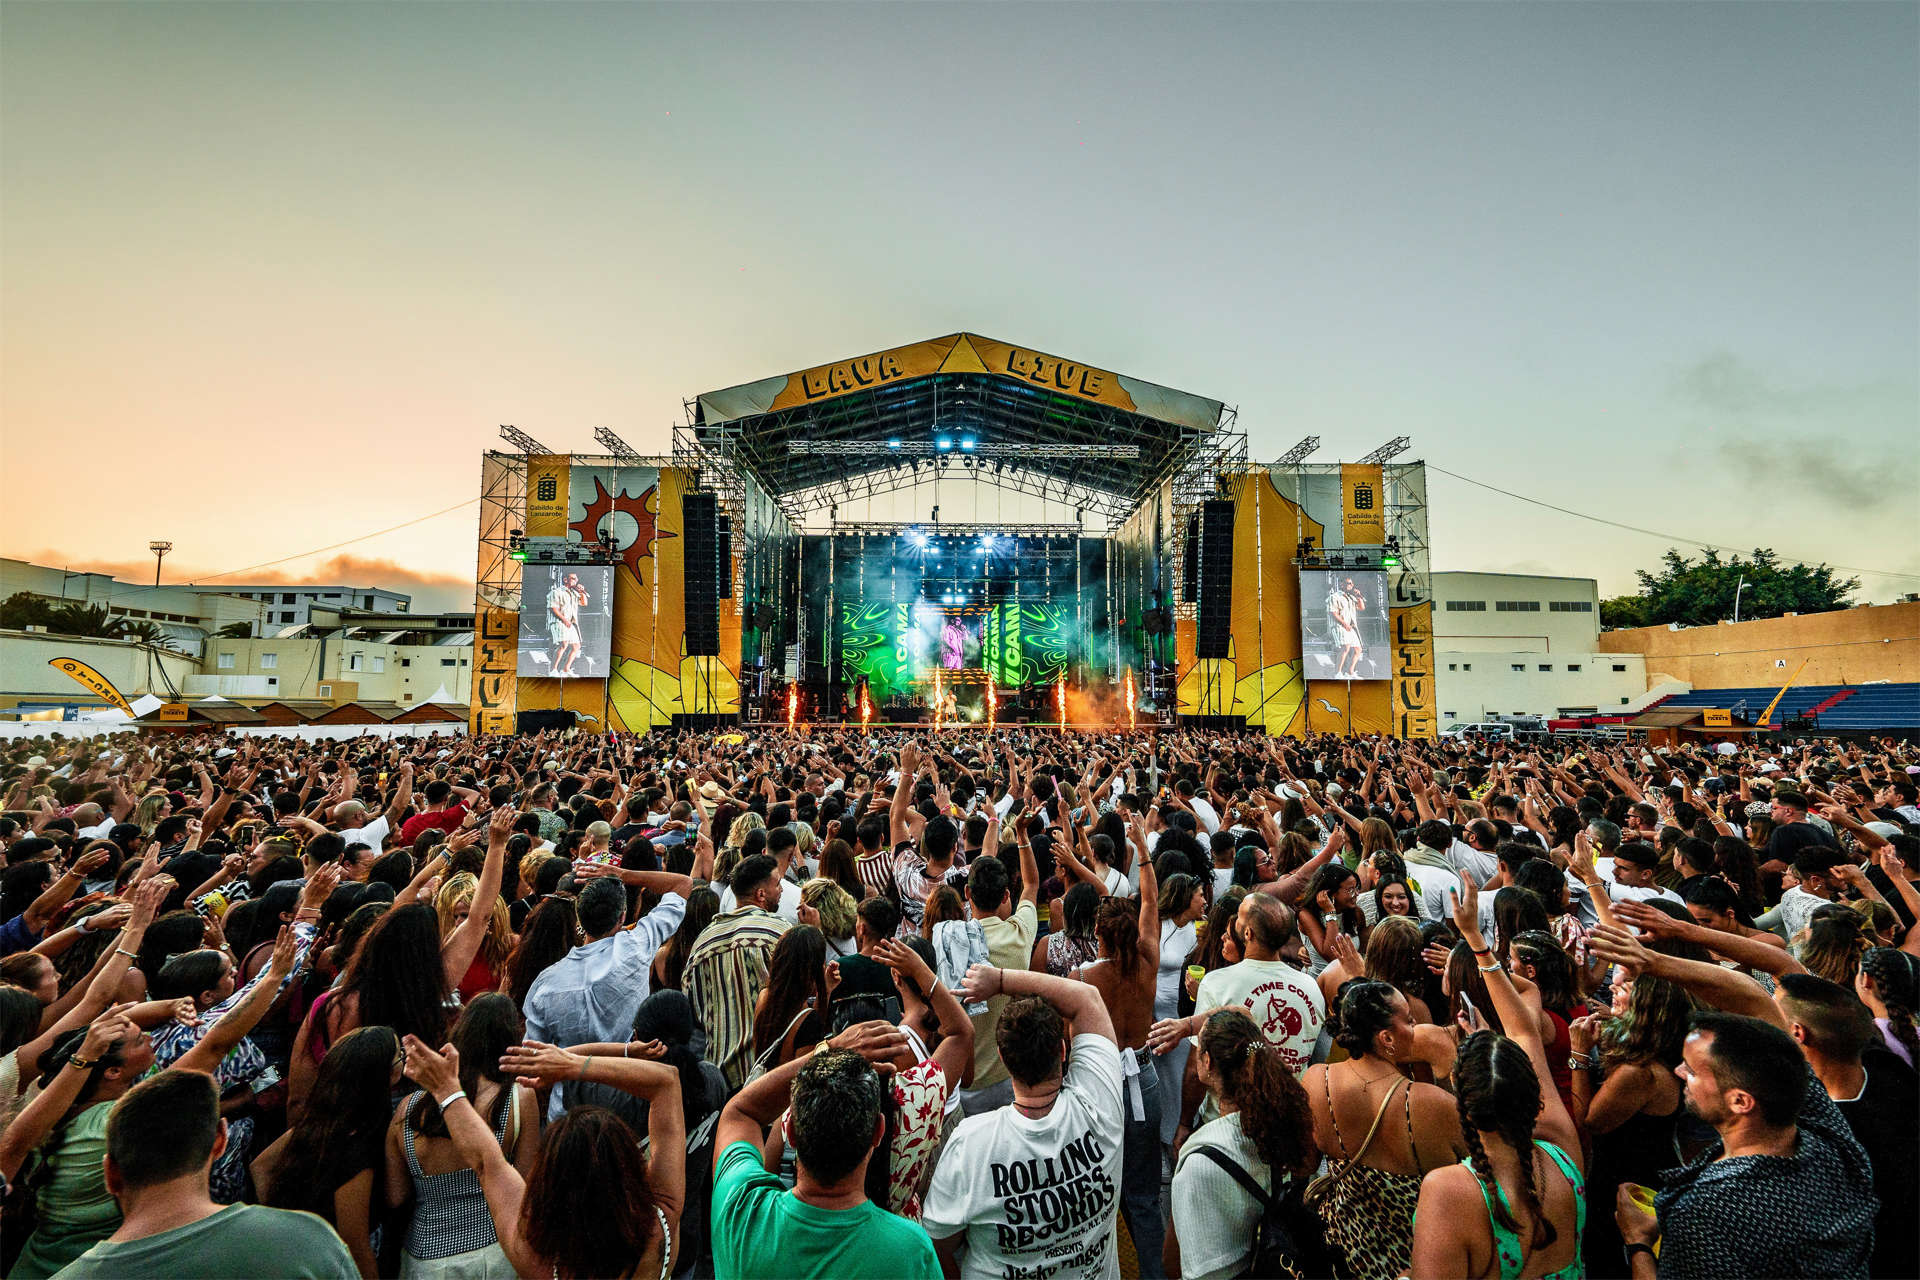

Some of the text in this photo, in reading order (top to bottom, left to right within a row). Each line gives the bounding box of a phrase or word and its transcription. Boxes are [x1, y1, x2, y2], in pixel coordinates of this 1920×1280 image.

[802, 349, 1104, 399] LAVA LIVE
[990, 603, 1000, 660] CAMA
[1396, 613, 1430, 741] LIVE
[1251, 981, 1285, 997] TIME
[1287, 984, 1318, 1026] COMES
[990, 1129, 1105, 1198] ROLLING
[1004, 1165, 1106, 1225] STONES
[1044, 1240, 1085, 1260] PRESENTS
